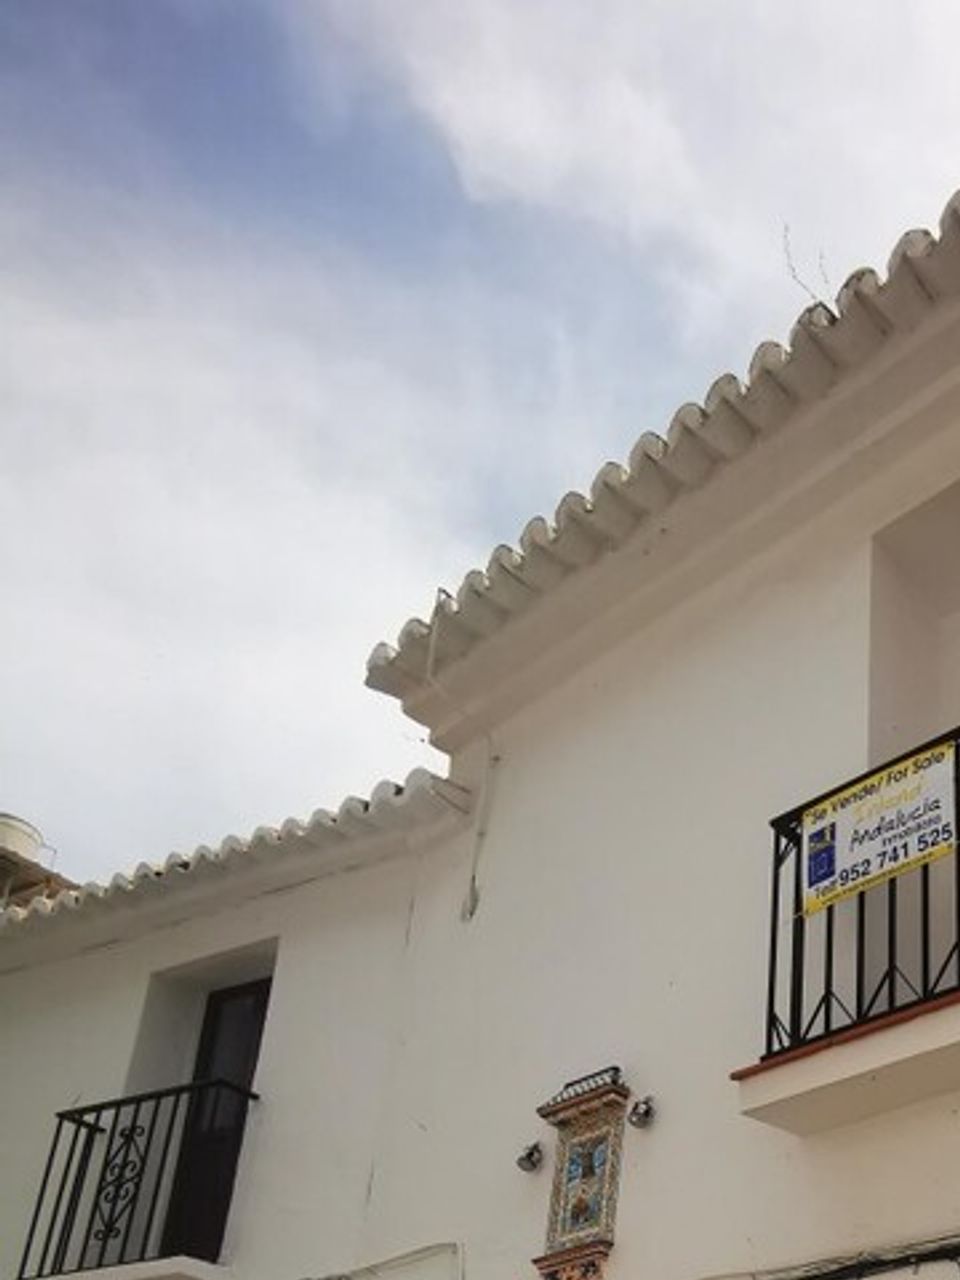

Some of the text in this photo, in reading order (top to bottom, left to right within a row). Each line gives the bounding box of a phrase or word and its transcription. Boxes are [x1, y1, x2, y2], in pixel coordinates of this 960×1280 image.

[886, 767, 909, 786] For
[911, 752, 946, 775] Sale
[838, 858, 872, 887] 952
[875, 843, 909, 869] 741
[916, 822, 954, 852] 525
